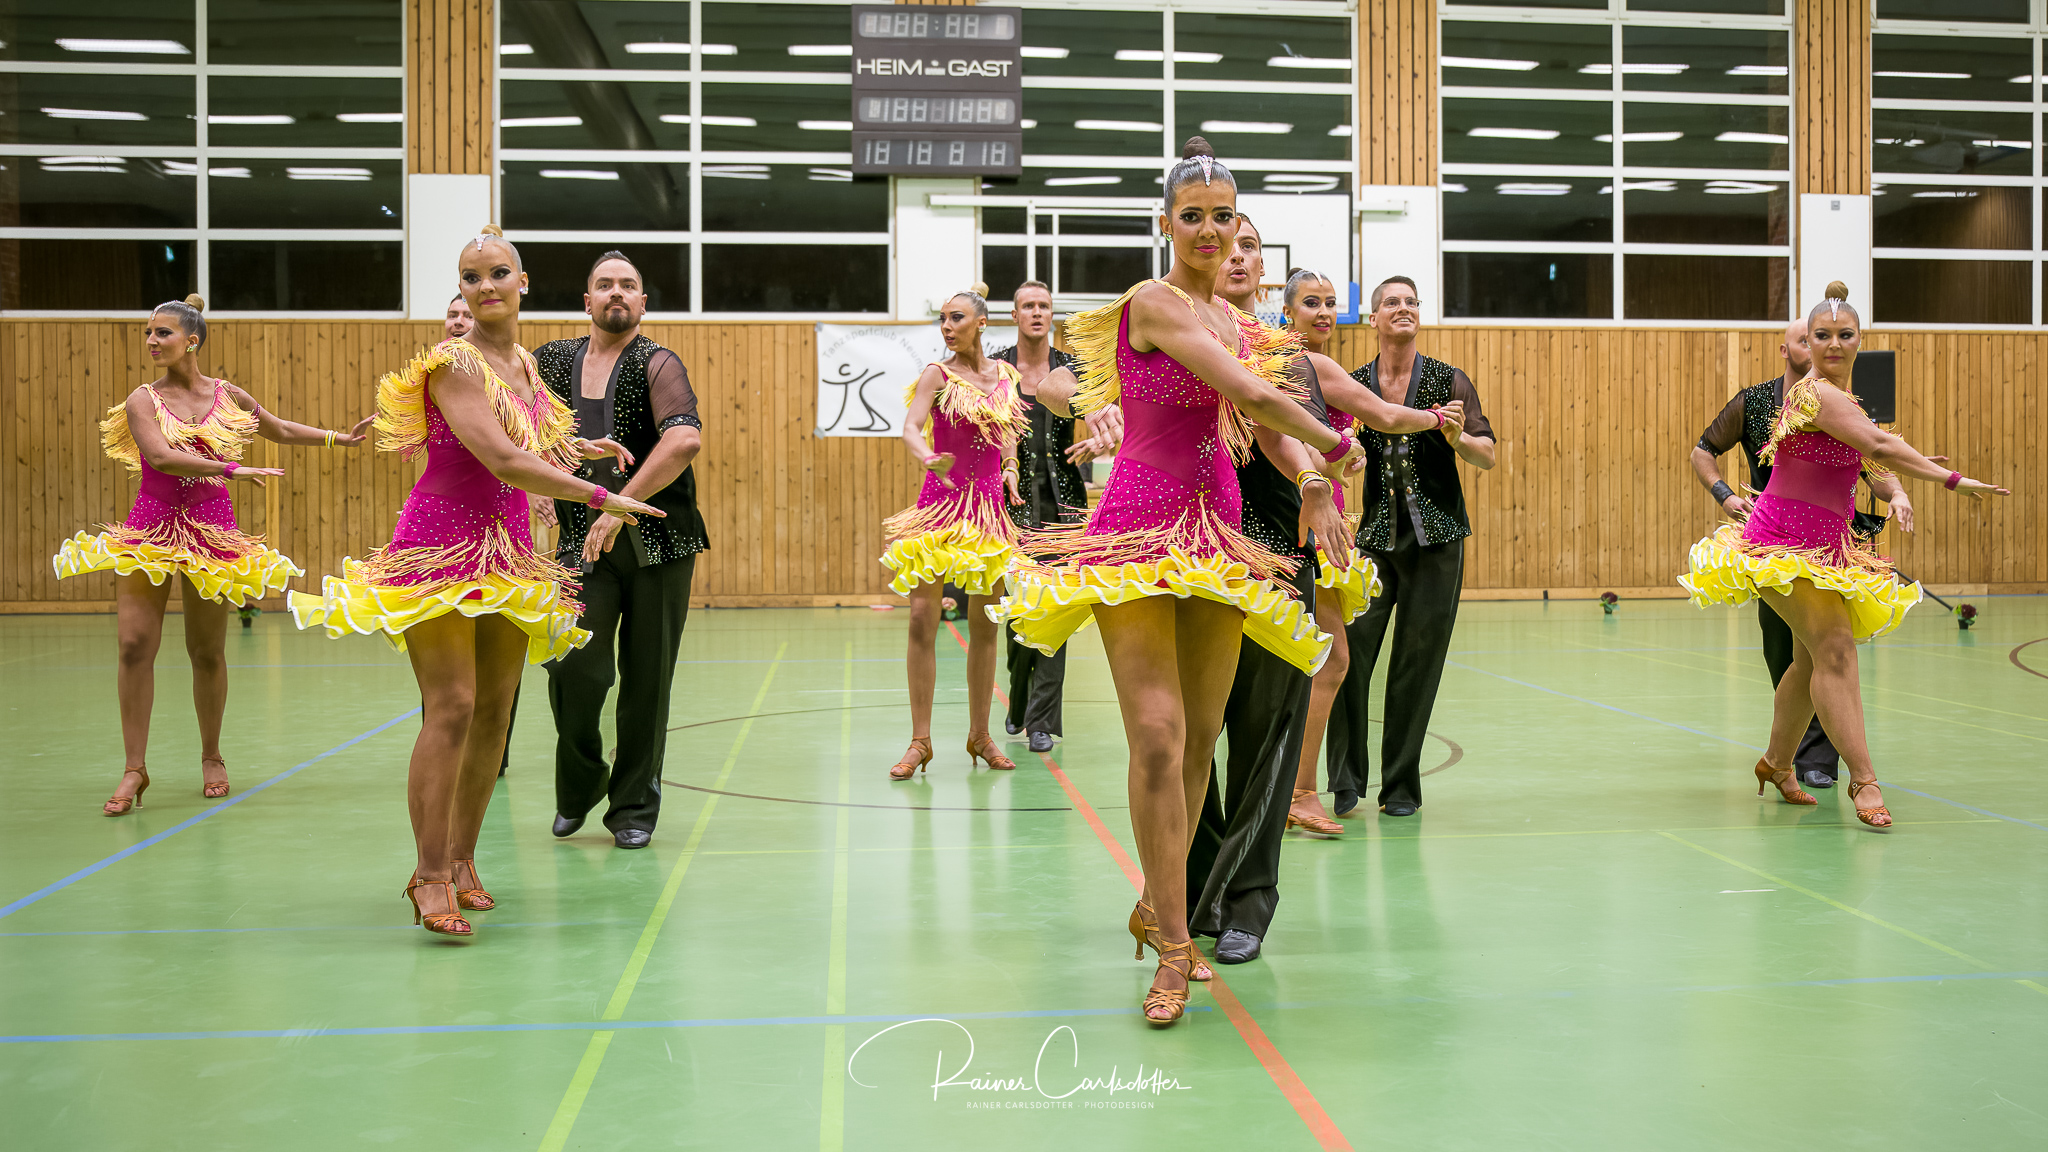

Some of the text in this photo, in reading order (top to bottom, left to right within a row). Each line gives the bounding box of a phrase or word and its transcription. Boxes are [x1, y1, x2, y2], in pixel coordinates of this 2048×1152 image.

[856, 58, 1013, 77] HEIM GAST
[822, 326, 898, 360] Tanzsportclub
